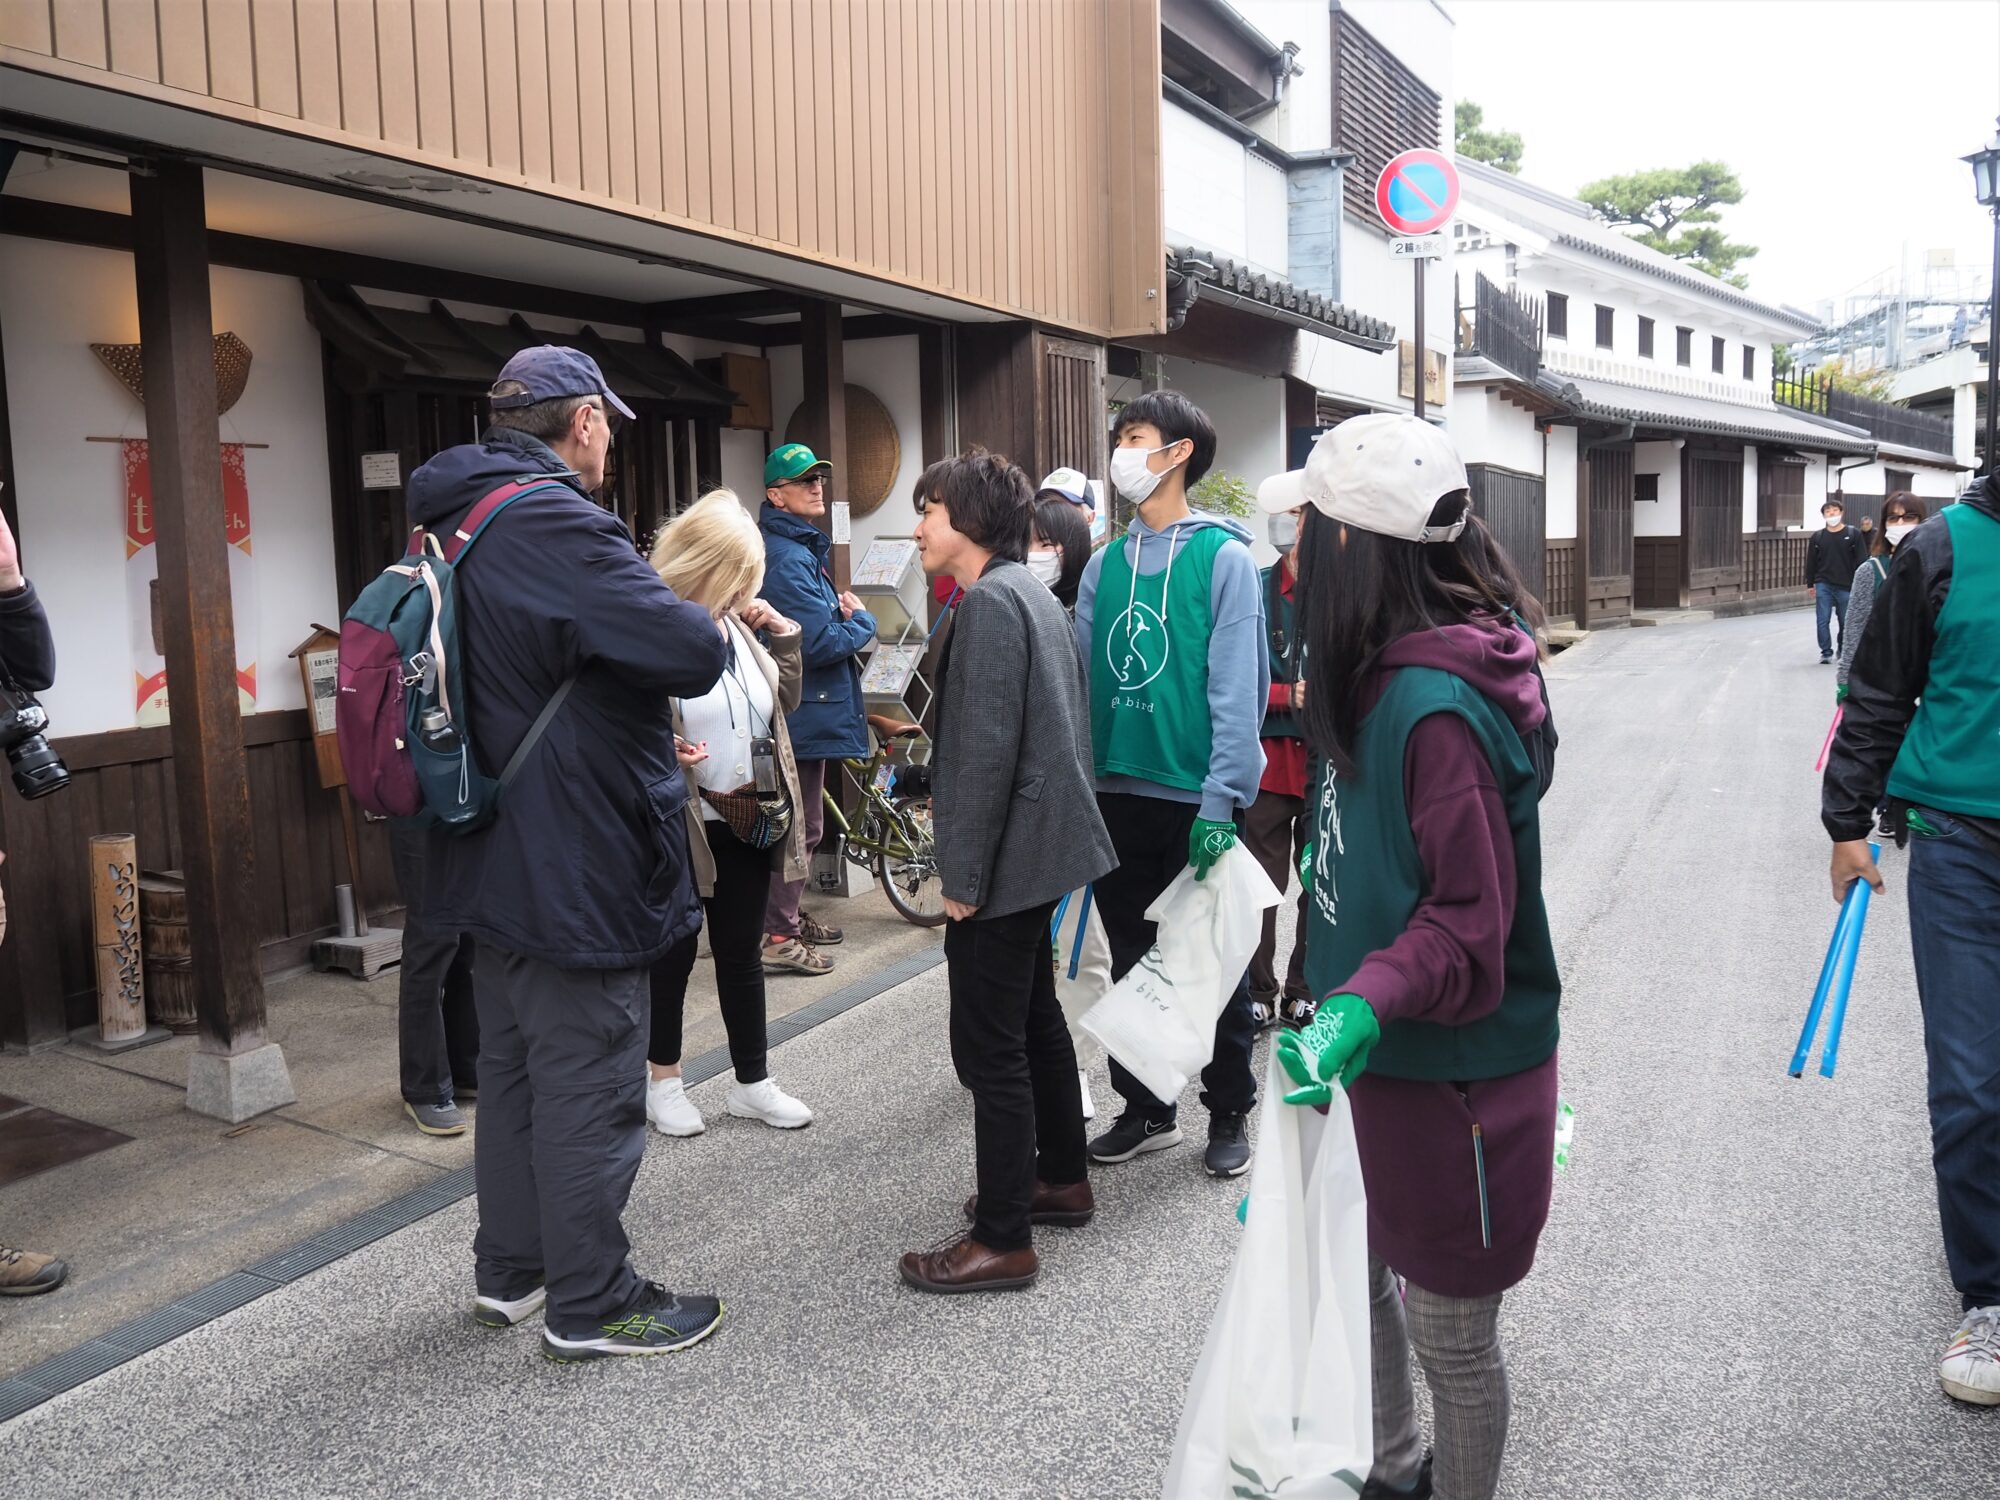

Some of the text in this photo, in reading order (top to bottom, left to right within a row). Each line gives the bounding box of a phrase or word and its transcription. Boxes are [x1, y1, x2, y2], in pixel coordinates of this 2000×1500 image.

[1395, 241, 1440, 254] 2輪を除く
[1125, 696, 1154, 713] bird
[1135, 982, 1169, 1012] bird
